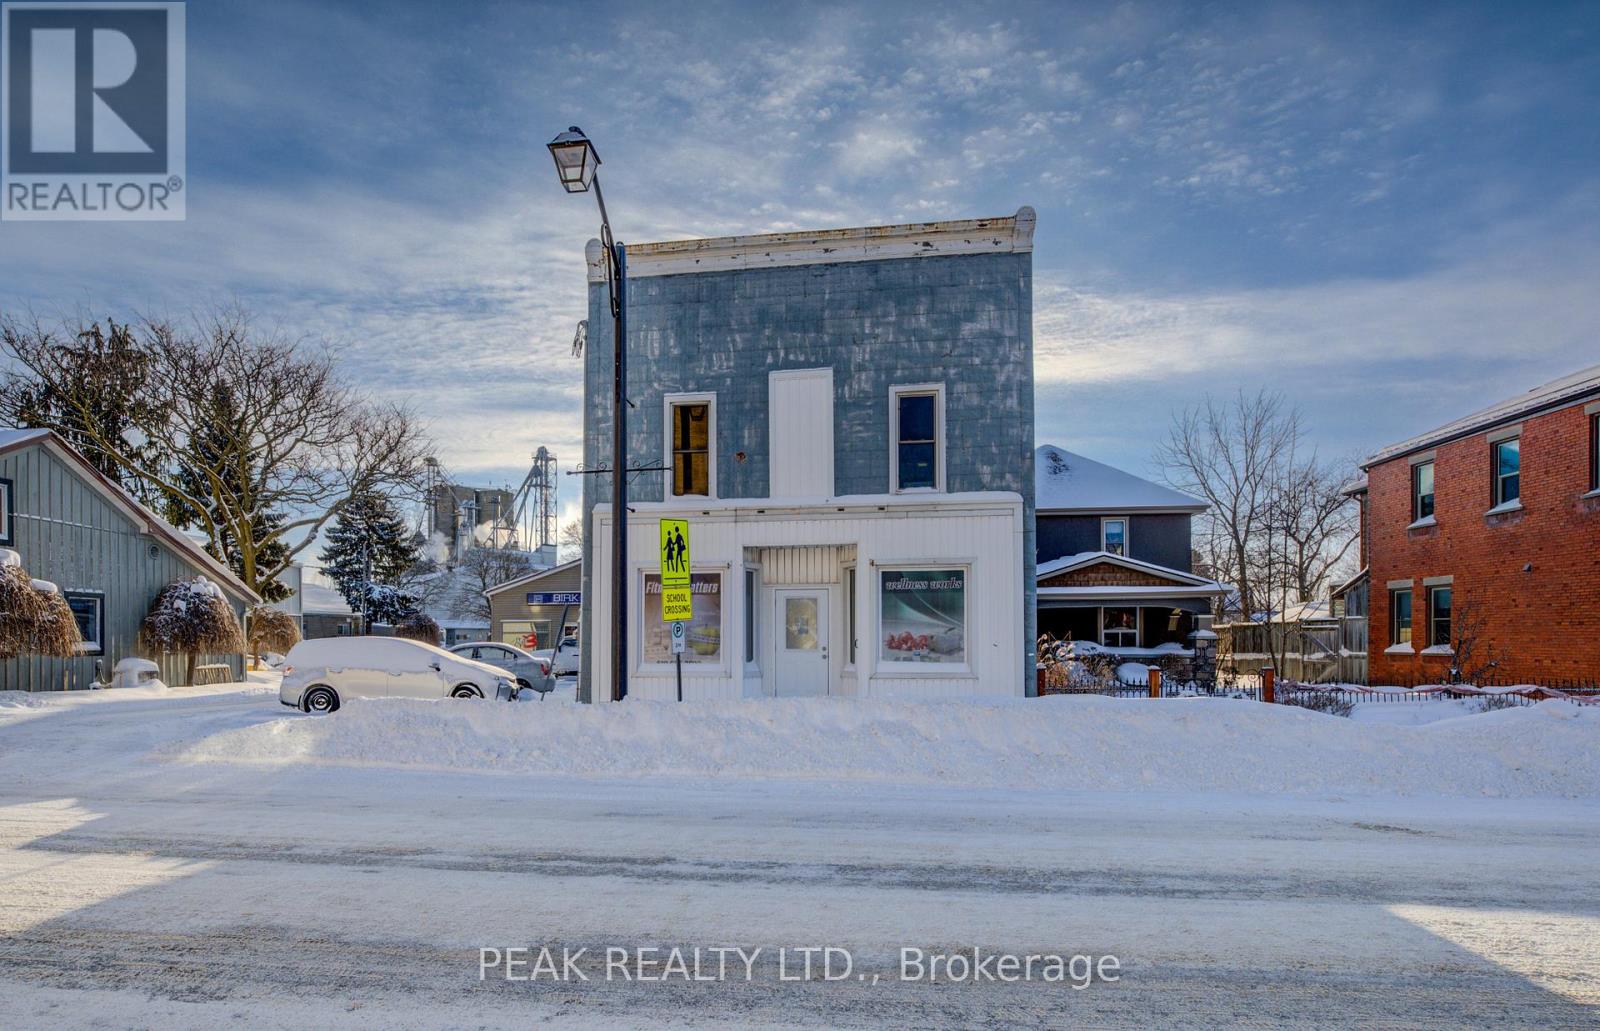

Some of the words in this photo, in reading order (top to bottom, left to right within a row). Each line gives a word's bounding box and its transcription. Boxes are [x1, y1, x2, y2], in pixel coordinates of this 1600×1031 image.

[691, 582, 718, 593] atters
[666, 593, 687, 603] SCHOOL
[665, 604, 690, 614] CROSSING
